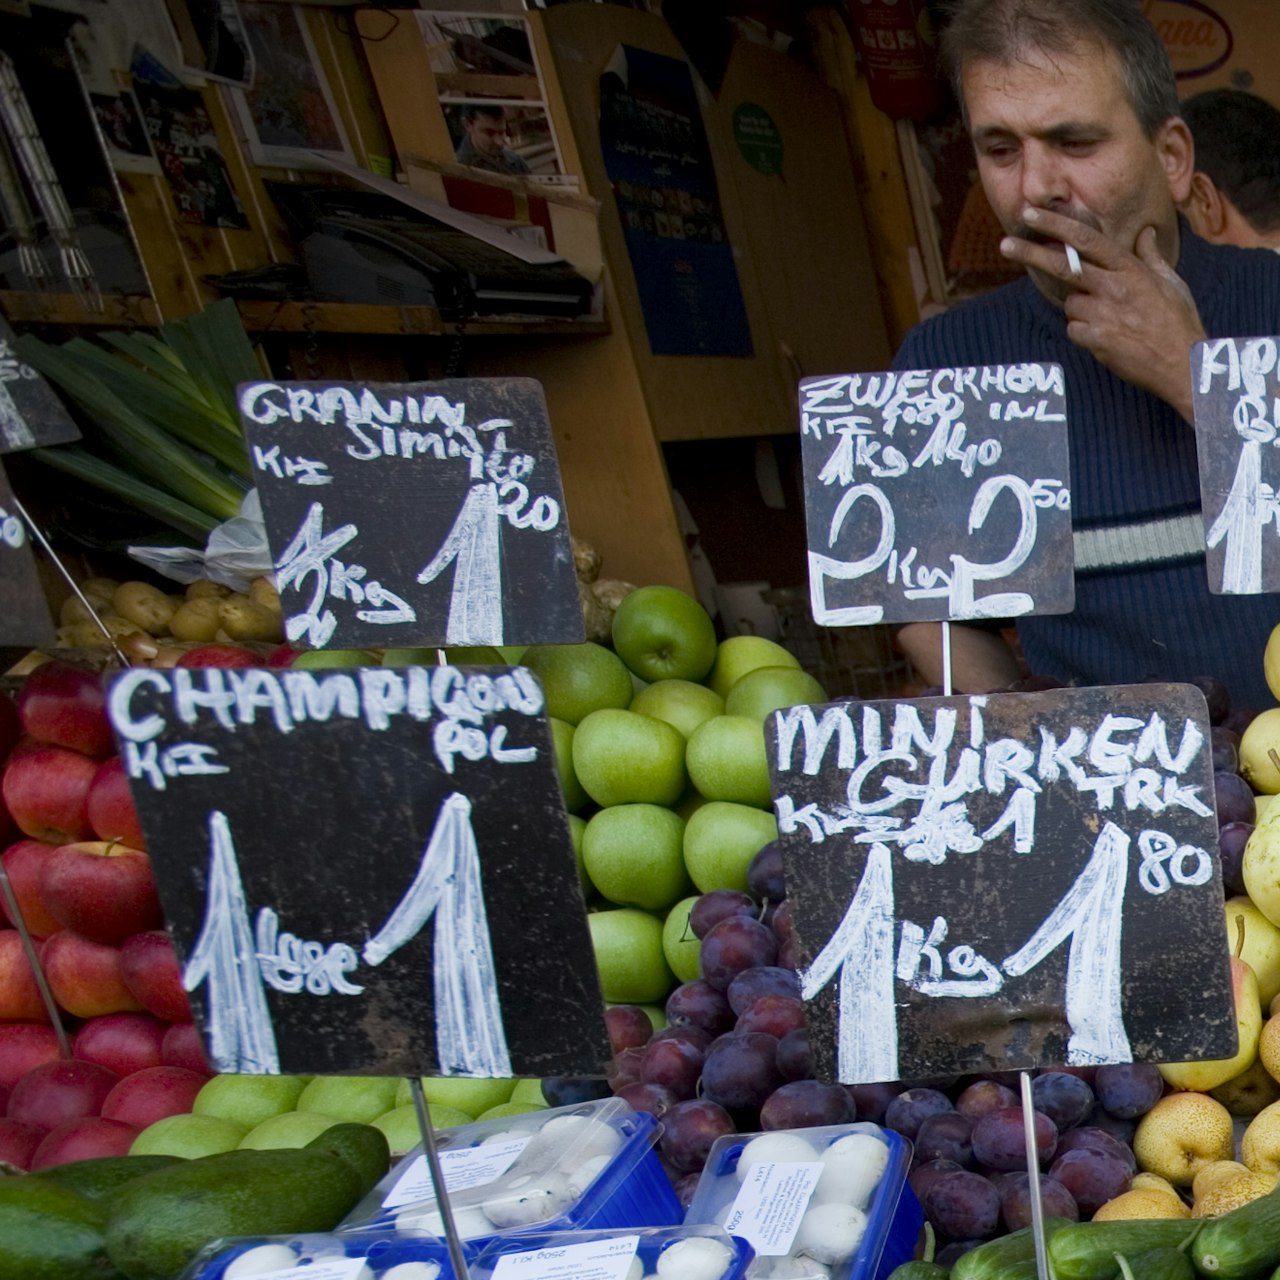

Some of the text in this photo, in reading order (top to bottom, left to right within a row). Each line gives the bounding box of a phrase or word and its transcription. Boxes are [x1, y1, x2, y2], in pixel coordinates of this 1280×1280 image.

[808, 483, 896, 627] 2
[774, 694, 990, 777] MINI
[536, 1249, 567, 1260] 250g
